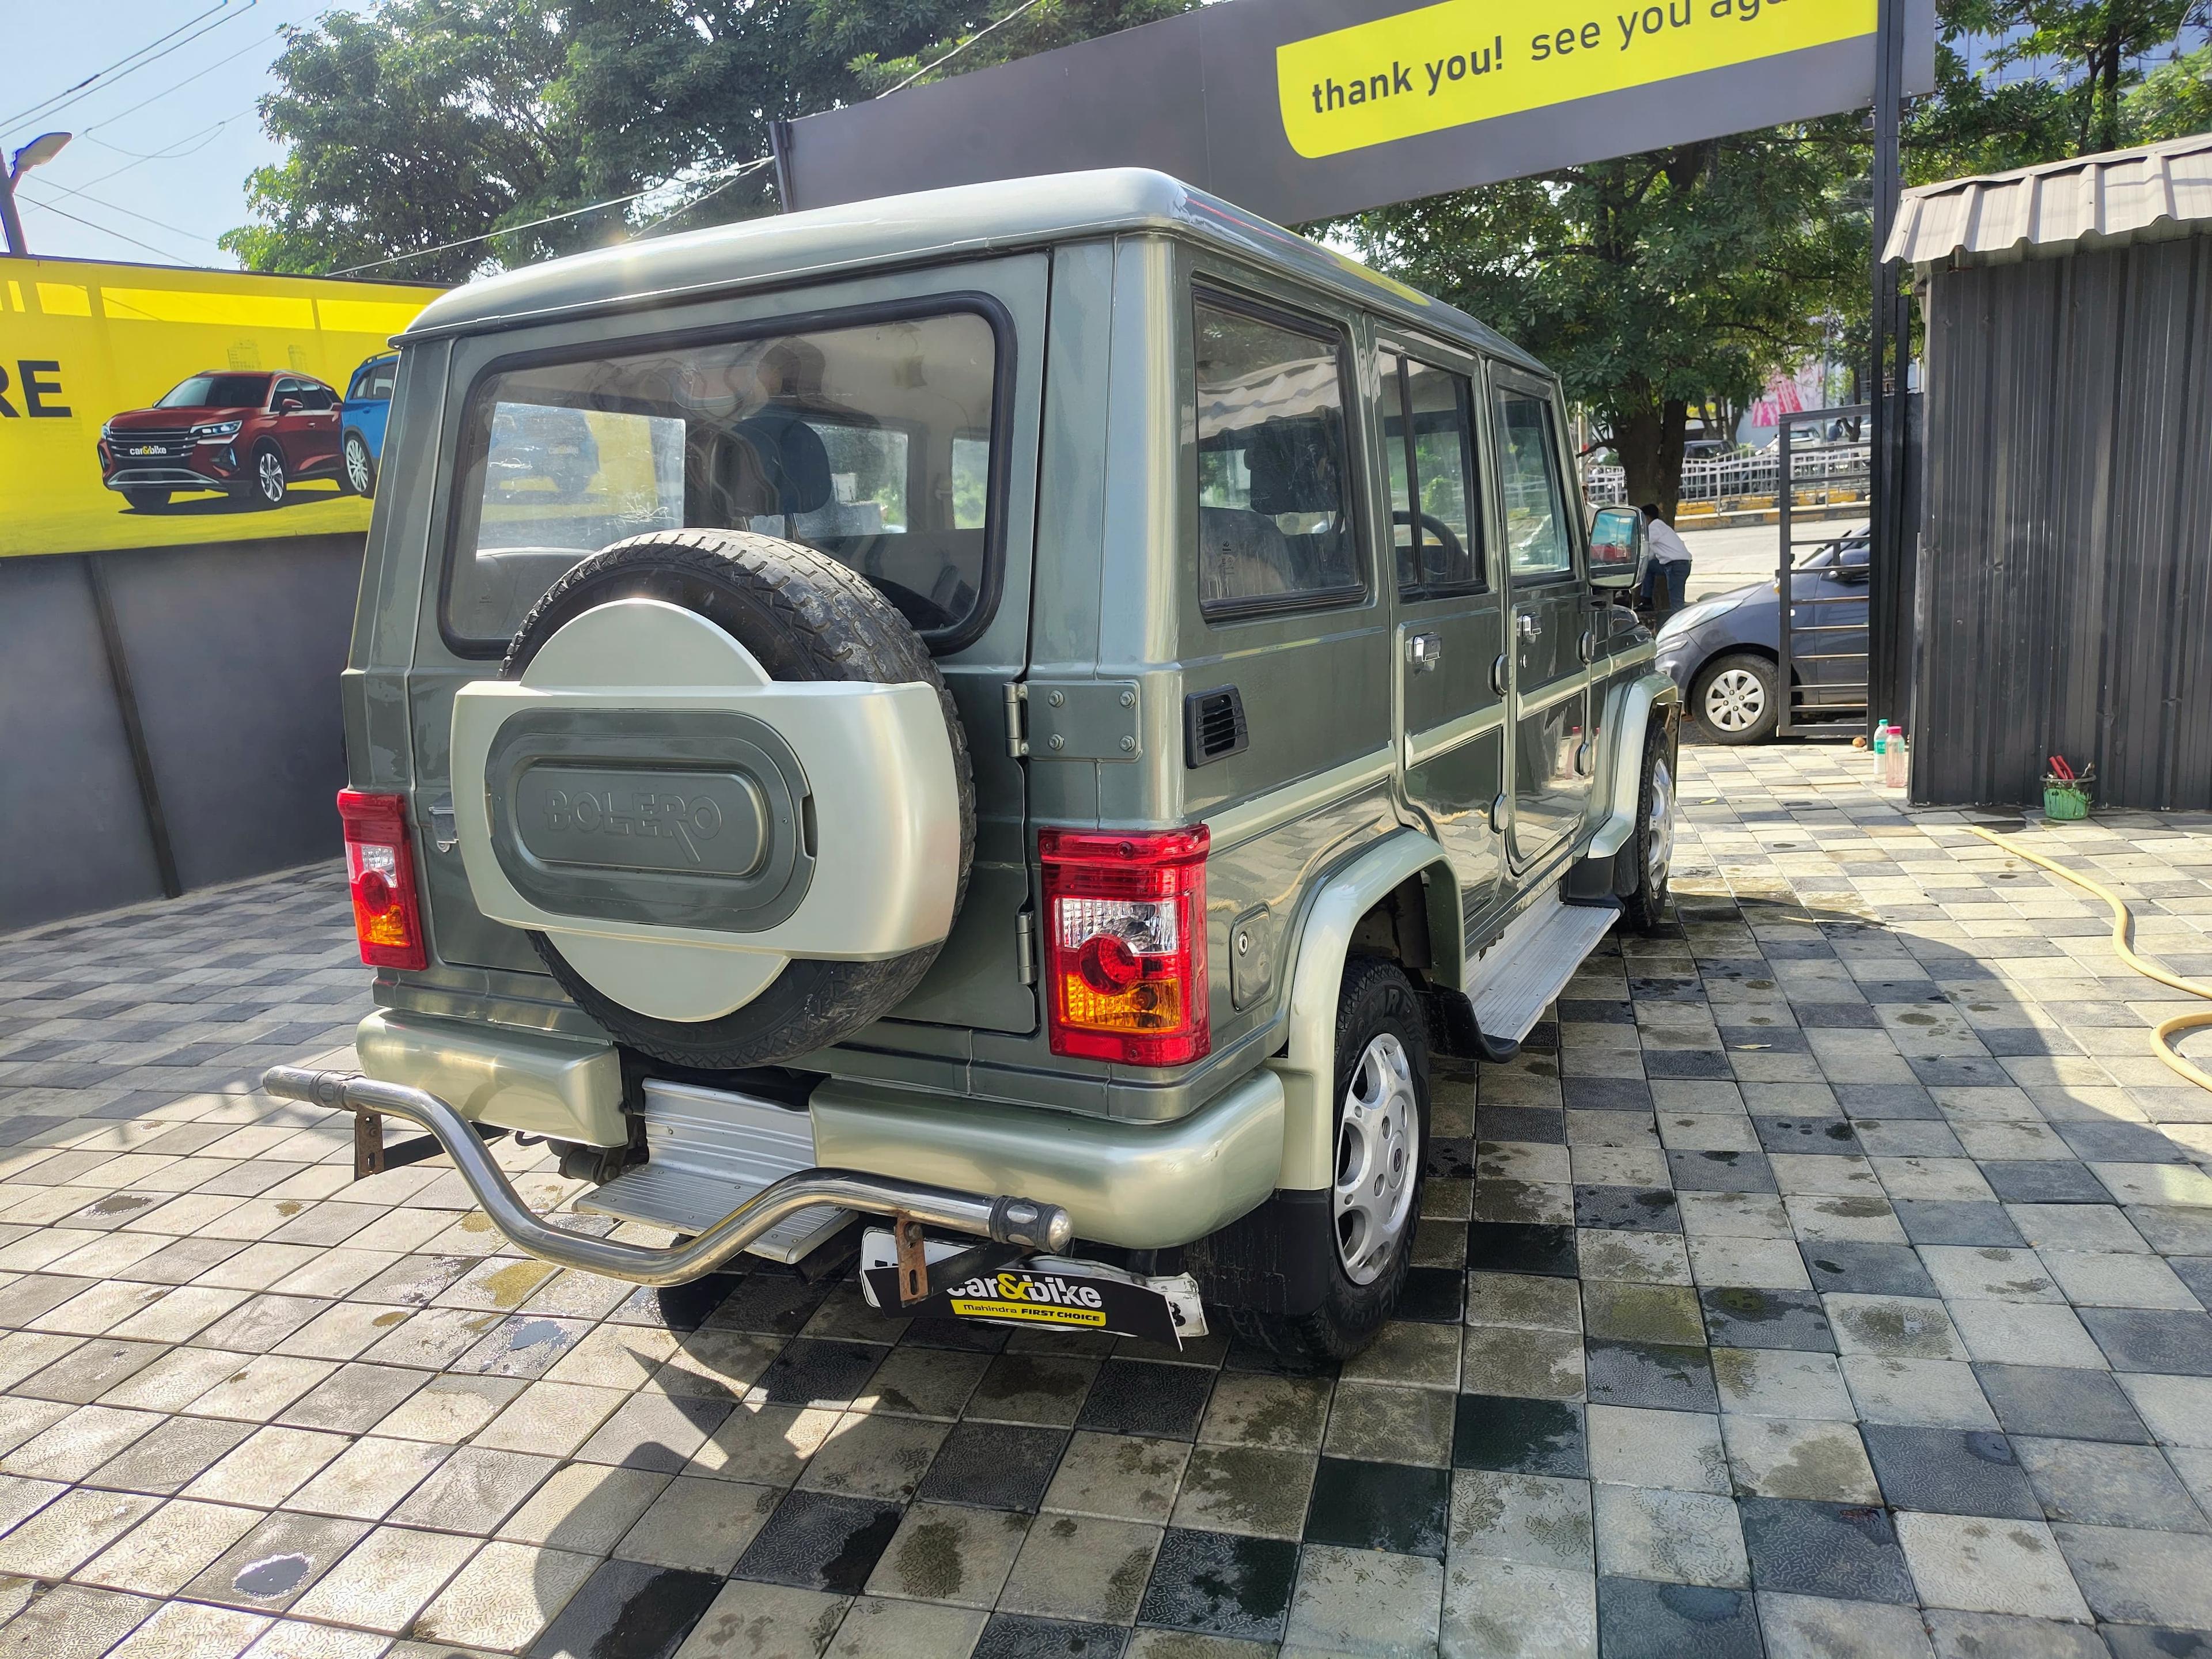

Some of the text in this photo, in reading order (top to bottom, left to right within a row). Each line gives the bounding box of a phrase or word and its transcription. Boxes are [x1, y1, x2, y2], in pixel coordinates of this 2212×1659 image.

[1312, 62, 1413, 113] thank
[1424, 35, 1502, 97] you!
[1531, 22, 1600, 61] see
[1616, 0, 1691, 51] you
[544, 788, 723, 863] BOLERO
[963, 1304, 1100, 1321] Mahindra FIRST CHOICE
